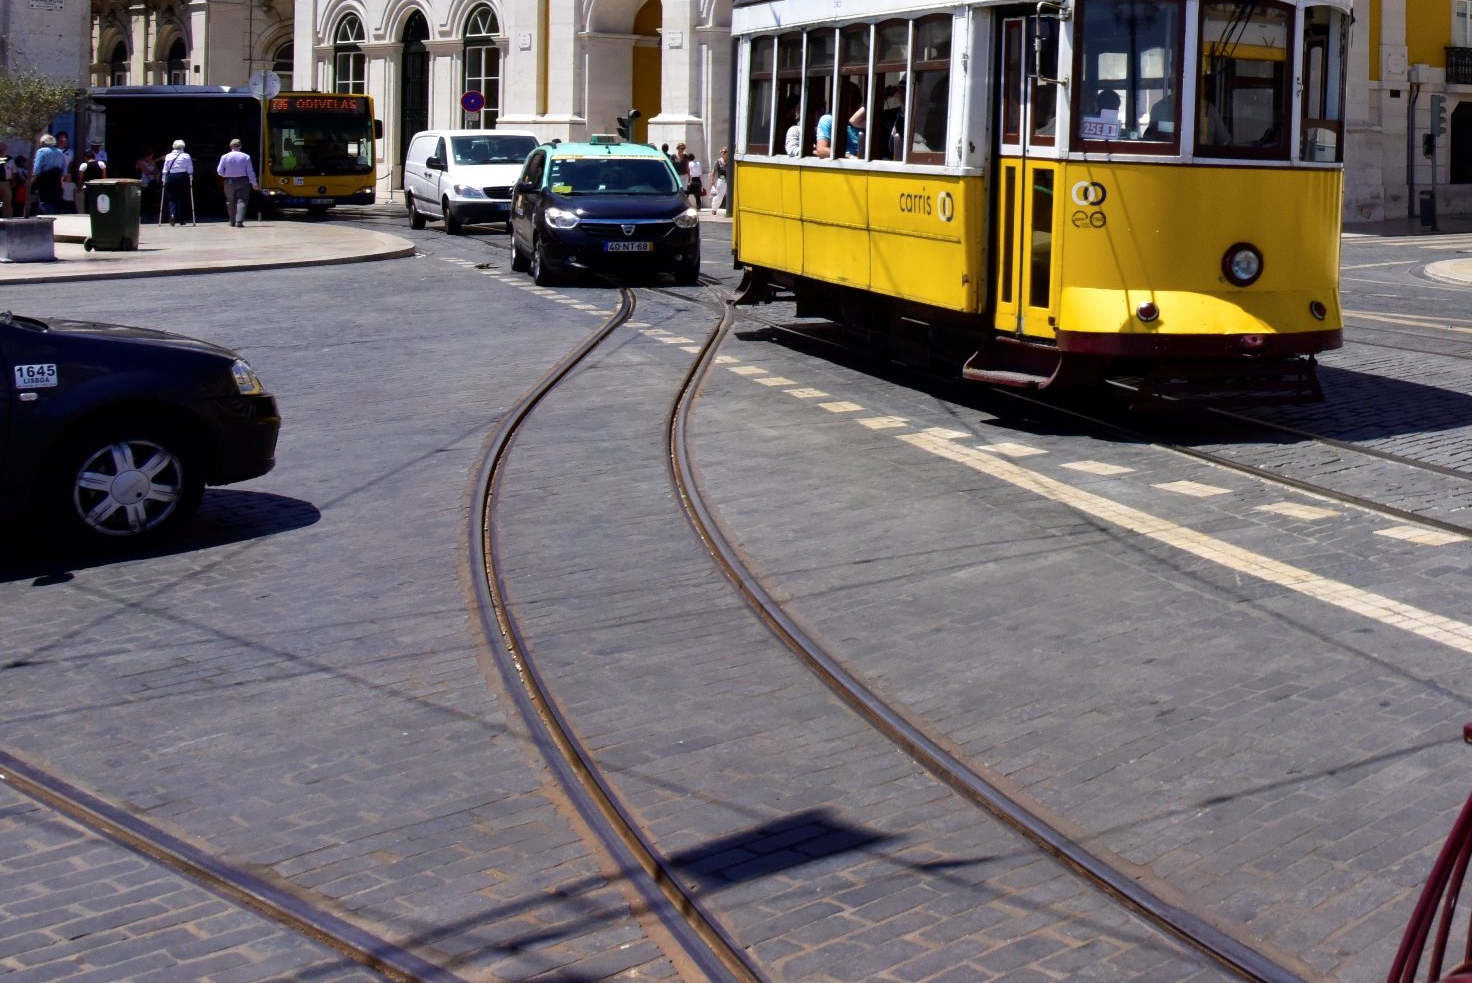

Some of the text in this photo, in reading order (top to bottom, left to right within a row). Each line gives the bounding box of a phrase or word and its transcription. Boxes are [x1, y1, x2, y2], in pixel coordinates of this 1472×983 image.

[295, 99, 358, 110] ODIVELAS
[1083, 122, 1103, 135] 25E
[899, 186, 932, 216] carris
[609, 242, 649, 251] 40-NT-68
[16, 365, 56, 378] 1645
